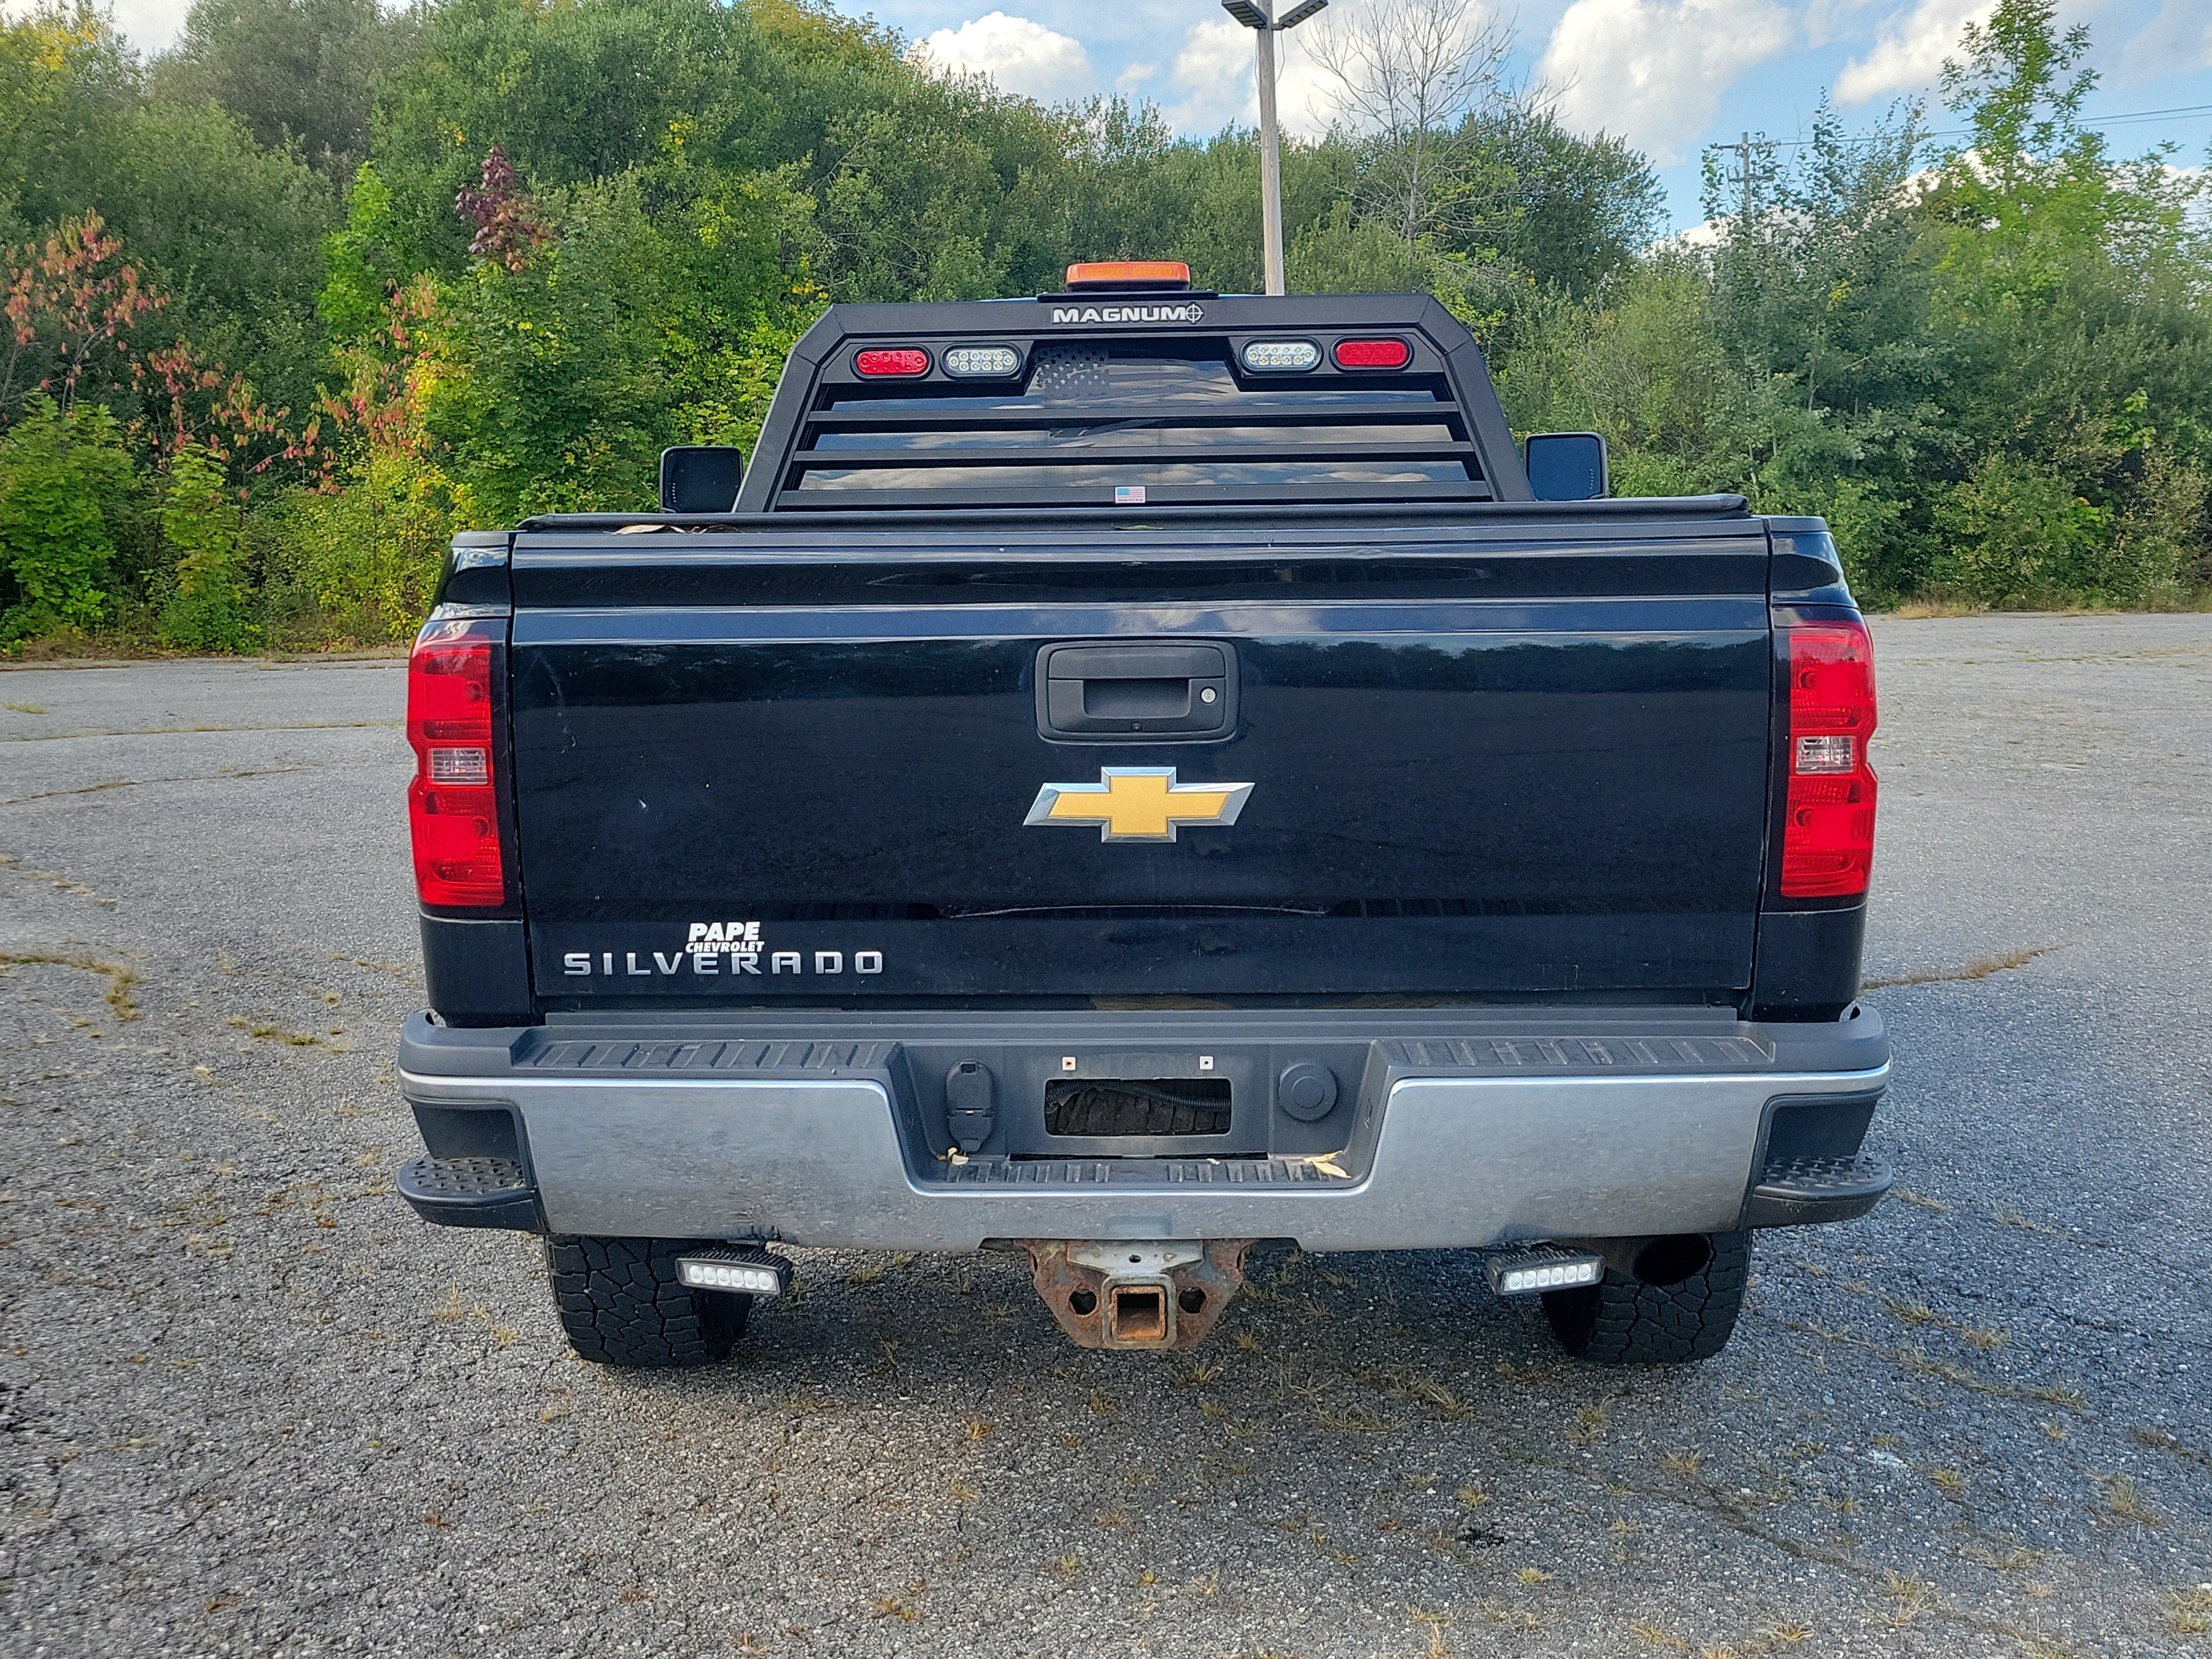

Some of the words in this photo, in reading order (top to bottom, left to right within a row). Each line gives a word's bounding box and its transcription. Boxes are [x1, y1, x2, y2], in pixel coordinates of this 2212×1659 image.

[1053, 307, 1186, 323] MAGNUM
[688, 921, 760, 942] PAPE
[685, 941, 765, 953] CHEVROLET
[563, 951, 883, 975] SILVERADO
